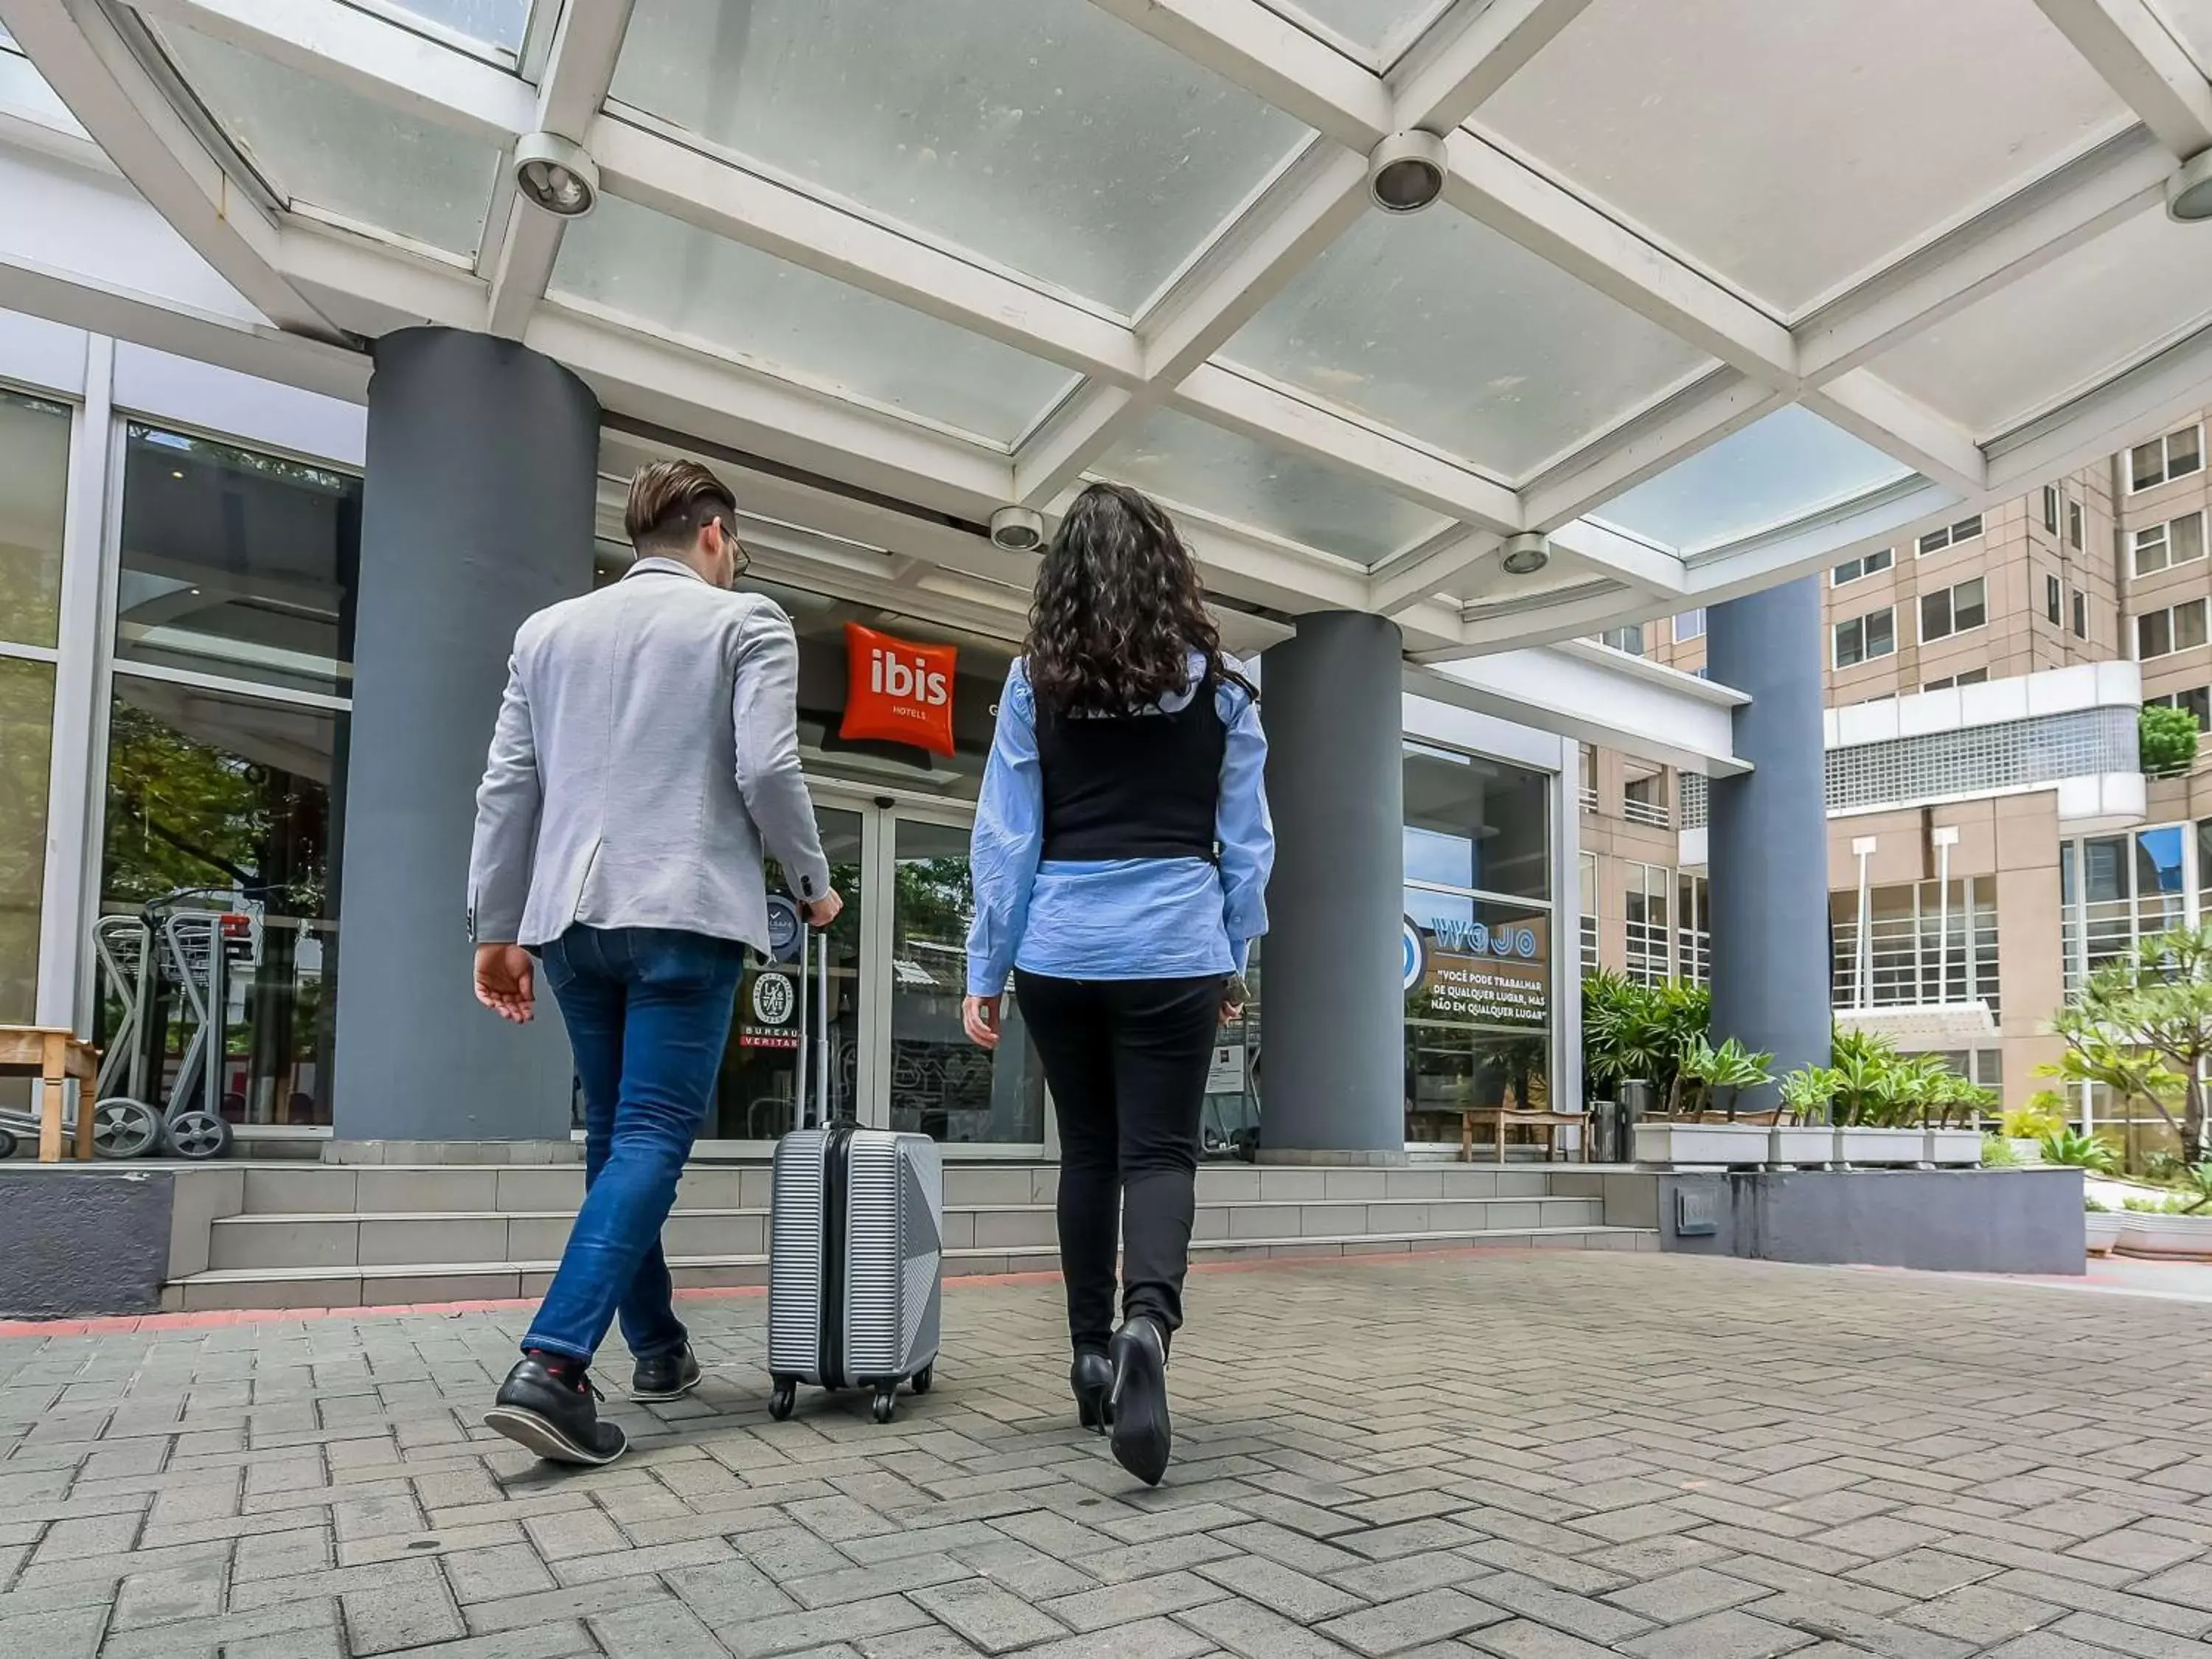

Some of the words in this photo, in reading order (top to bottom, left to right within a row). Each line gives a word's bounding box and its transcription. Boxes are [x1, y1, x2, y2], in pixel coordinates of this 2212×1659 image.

[872, 649, 947, 705] ibis
[893, 705, 926, 720] HOTELS
[1470, 974, 1493, 986] PODE
[1494, 975, 1542, 991] TRABALHAR
[1434, 984, 1446, 995] DE
[1447, 986, 1495, 1001] QUALQUER
[1496, 992, 1527, 1006] LUGAR,
[1528, 995, 1545, 1006] MAS
[1431, 998, 1452, 1011] NÃO
[1453, 1001, 1466, 1012] EM
[1468, 1004, 1514, 1018] QUALQUER
[745, 1026, 797, 1037] BUREAU
[745, 1037, 797, 1046] VERITAS
